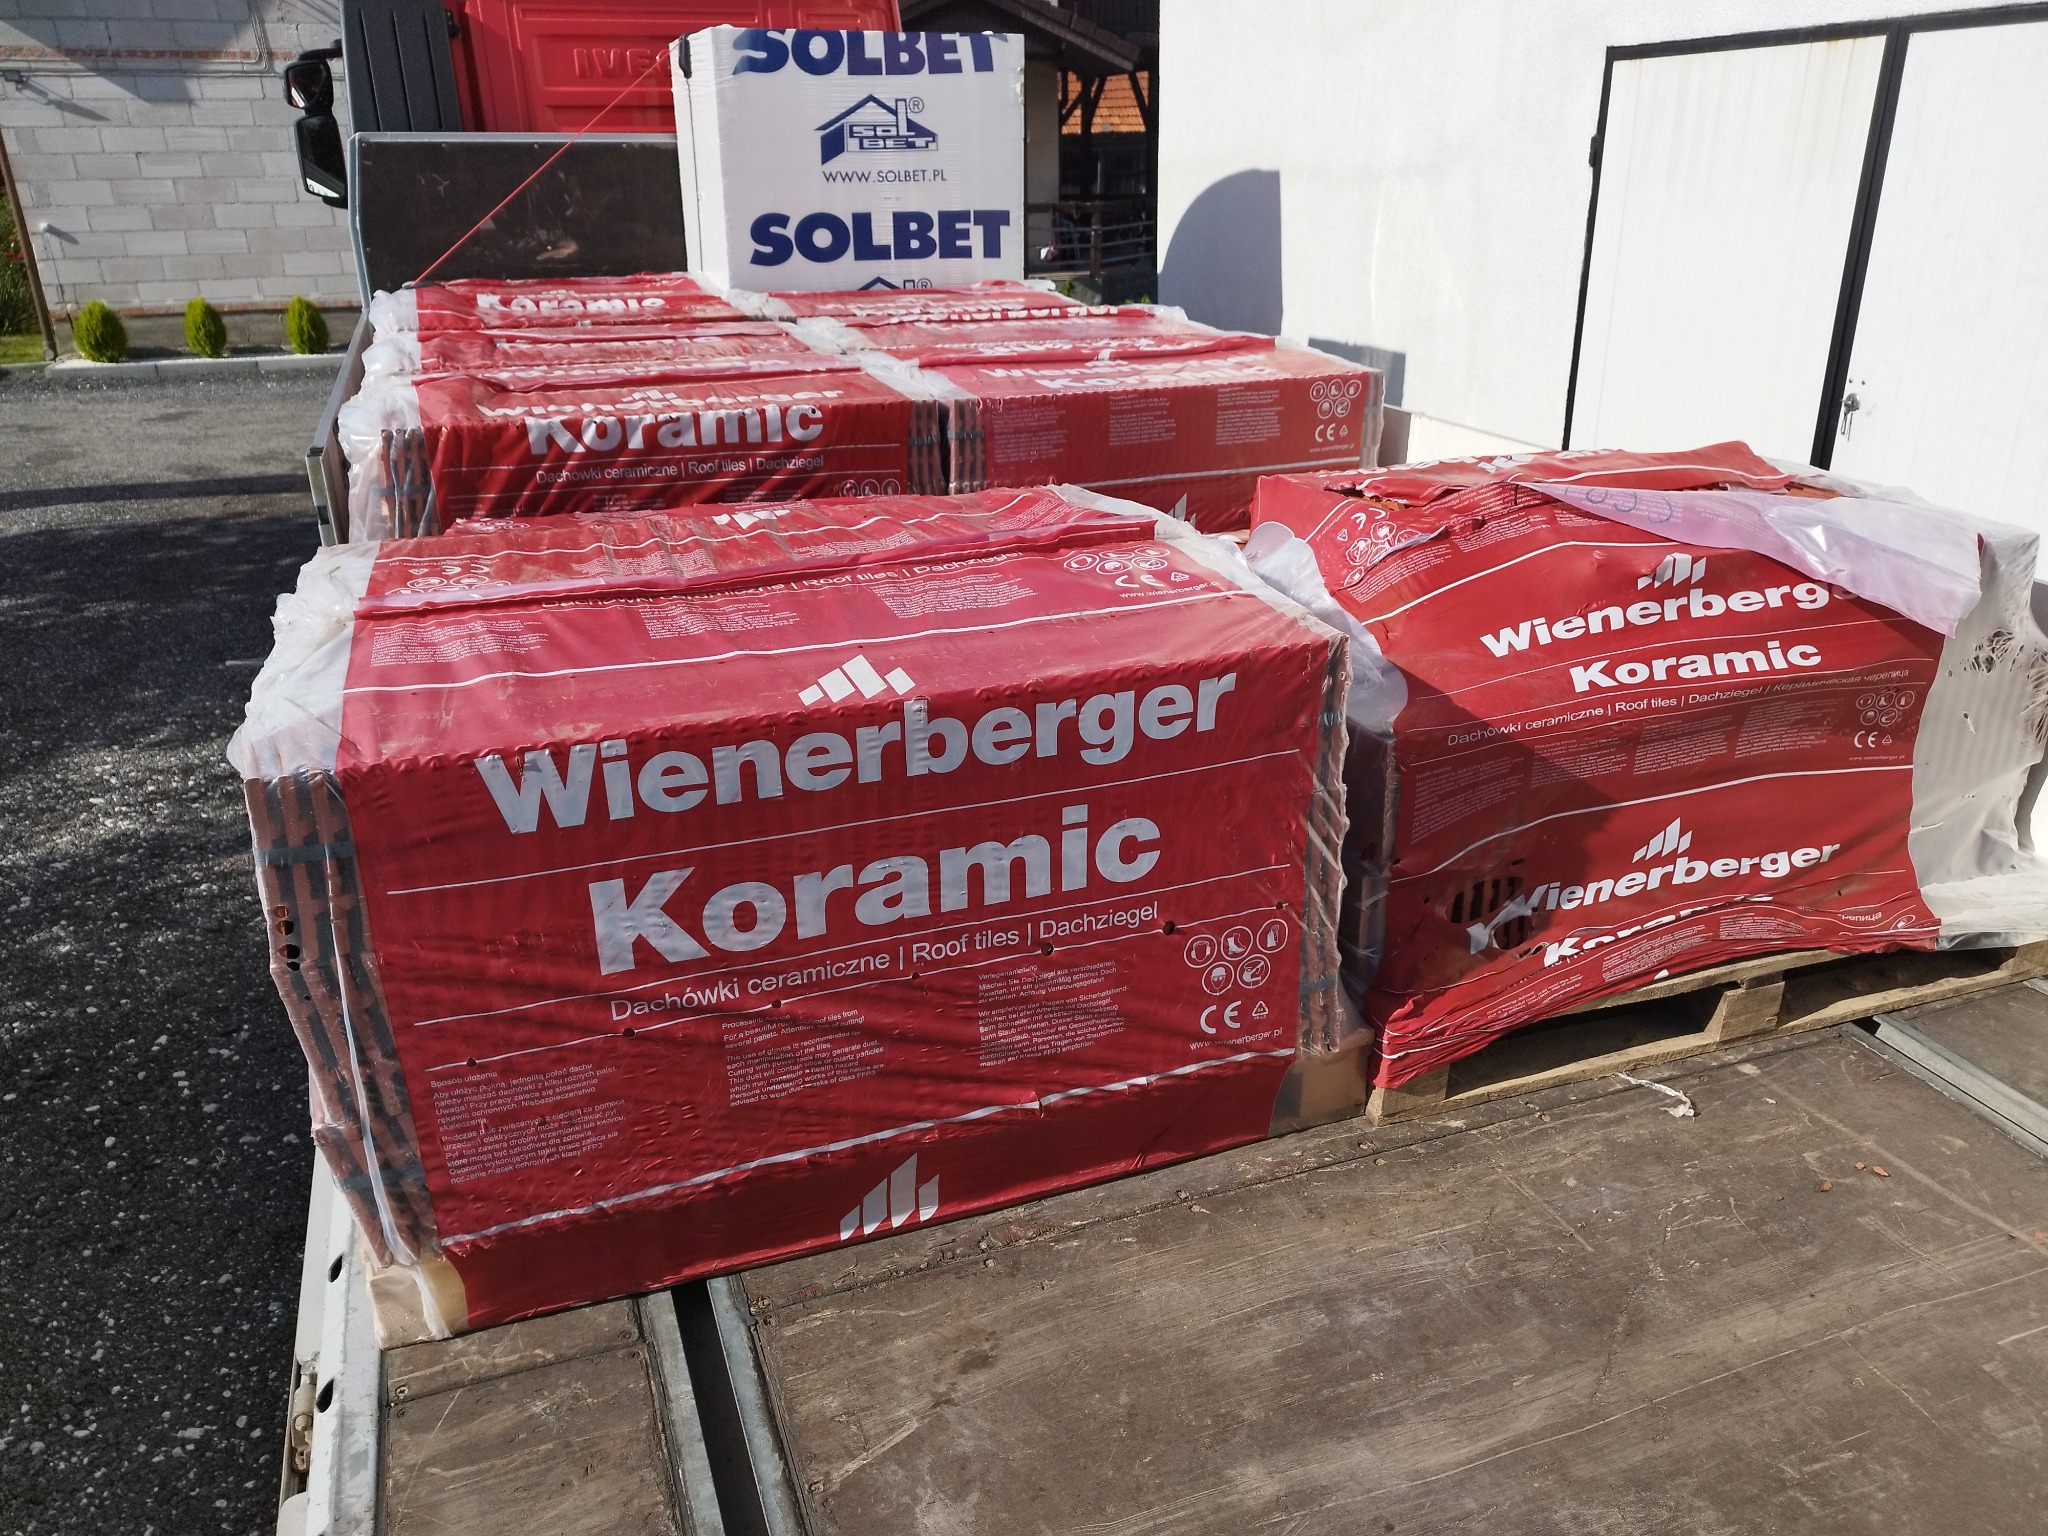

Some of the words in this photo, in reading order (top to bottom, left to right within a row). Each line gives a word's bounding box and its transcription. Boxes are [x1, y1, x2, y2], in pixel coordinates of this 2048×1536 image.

[732, 29, 1007, 76] SOLBET
[823, 169, 947, 183] WWW.SOLBET.PL
[750, 210, 1010, 266] SOLBET
[524, 402, 824, 456] Koramic
[604, 462, 677, 480] ceramiczne
[688, 459, 720, 475] Roof
[722, 459, 746, 473] tiles
[756, 455, 824, 472] Dachziegel
[857, 570, 898, 582] tiles
[1568, 640, 1821, 693] Koramic
[1448, 722, 1522, 746] Dachówki
[1525, 706, 1604, 731] ceramiczne
[1615, 700, 1648, 713] Roof
[1651, 696, 1677, 708] tiles
[1689, 685, 1763, 703] Dachziegel
[1855, 731, 1879, 748] CE
[474, 672, 1236, 834] Wienerberger
[589, 804, 1161, 975] Koramic
[610, 977, 740, 1021] Dachówki
[747, 952, 890, 995] ceramiczne
[912, 933, 971, 963] Roof
[974, 926, 1019, 950] tiles
[1039, 901, 1159, 940] Dachziegel
[1200, 1000, 1242, 1035] CE
